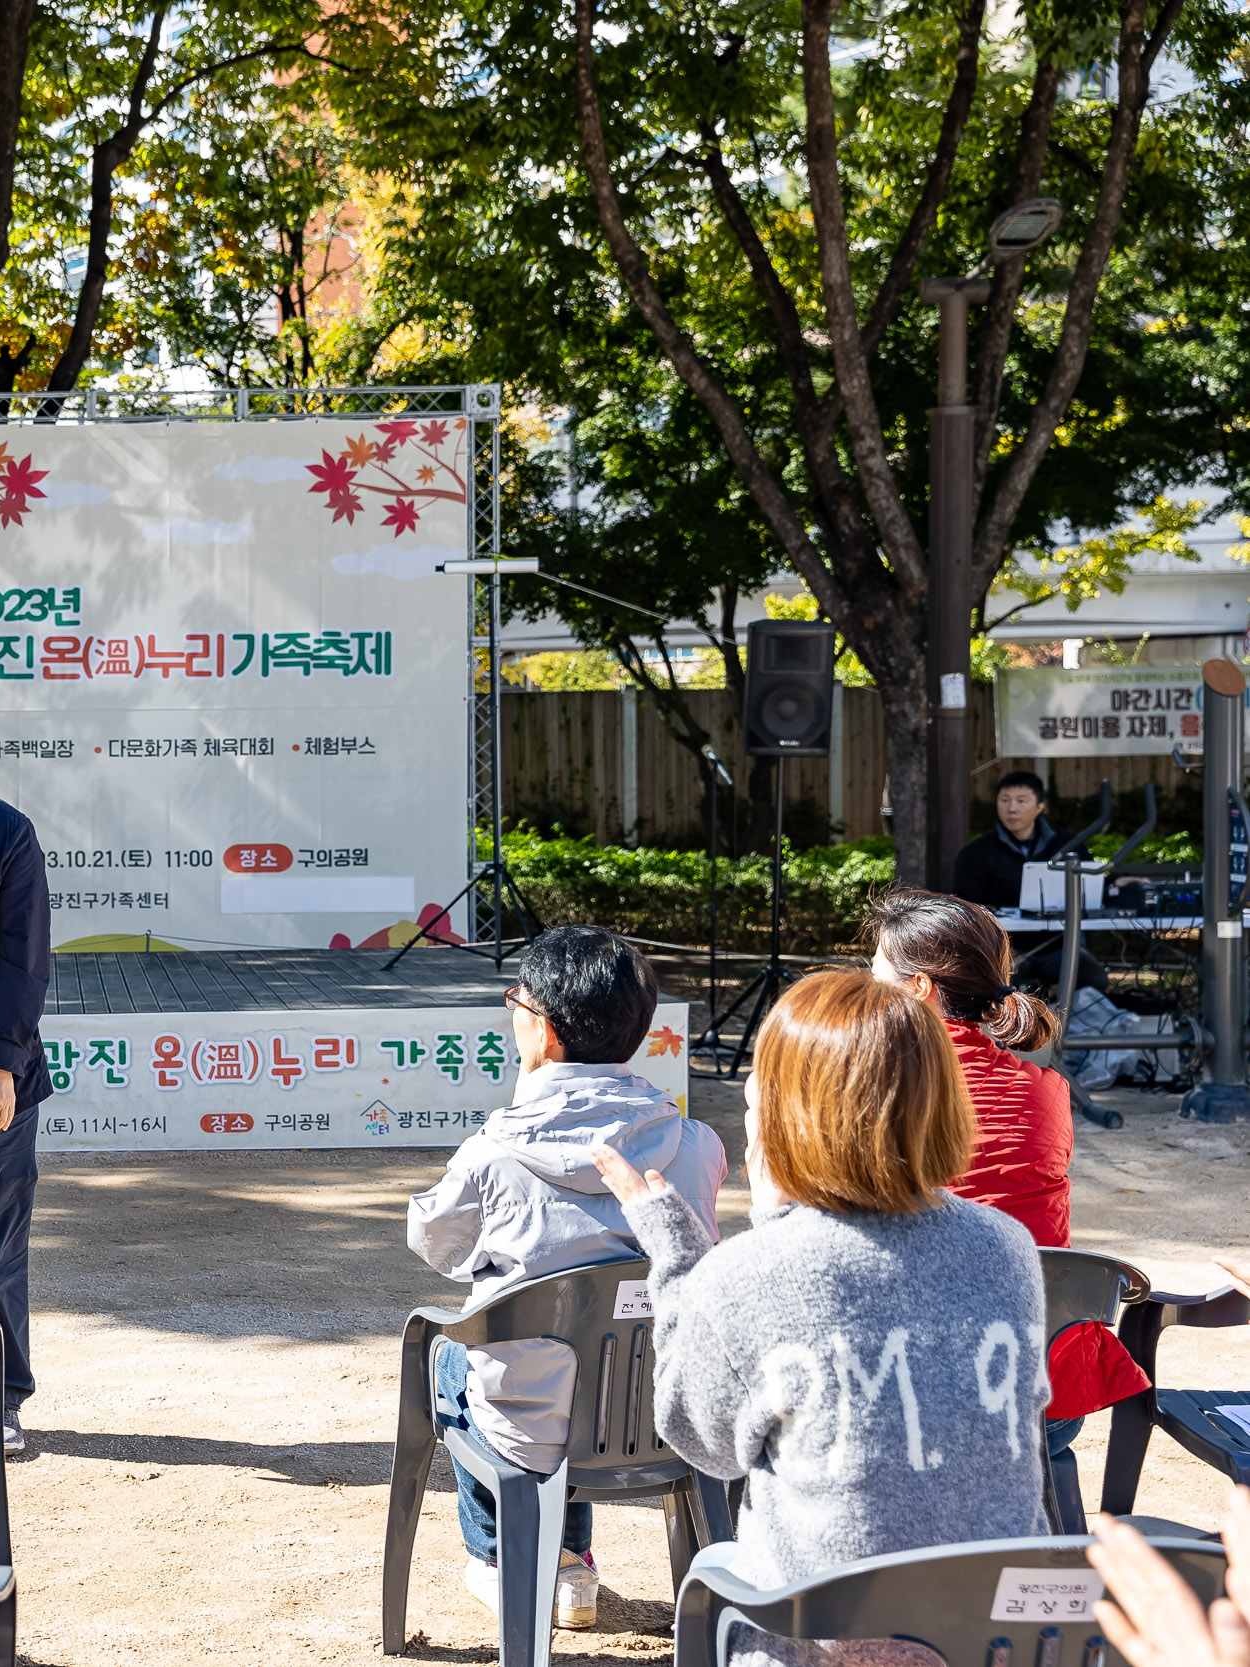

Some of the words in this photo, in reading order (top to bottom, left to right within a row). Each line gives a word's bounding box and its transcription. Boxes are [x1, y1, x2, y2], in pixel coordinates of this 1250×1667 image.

[40, 633, 225, 680] 온(溫)누리
[231, 631, 392, 678] 가족축제
[1039, 715, 1120, 740] 공원이용
[109, 738, 198, 758] 다문화가족
[203, 737, 274, 757] 체육대회
[304, 736, 376, 755] 체험부스
[165, 849, 213, 868] 11:00
[297, 847, 369, 868] 구의공원
[49, 891, 168, 909] 광진구가족센터
[37, 1039, 126, 1089] 광진
[152, 1035, 359, 1087] 온(溫)누리
[381, 1031, 521, 1081] 가족축
[81, 1115, 167, 1135] 11시~16시
[264, 1113, 330, 1132] 구의공원
